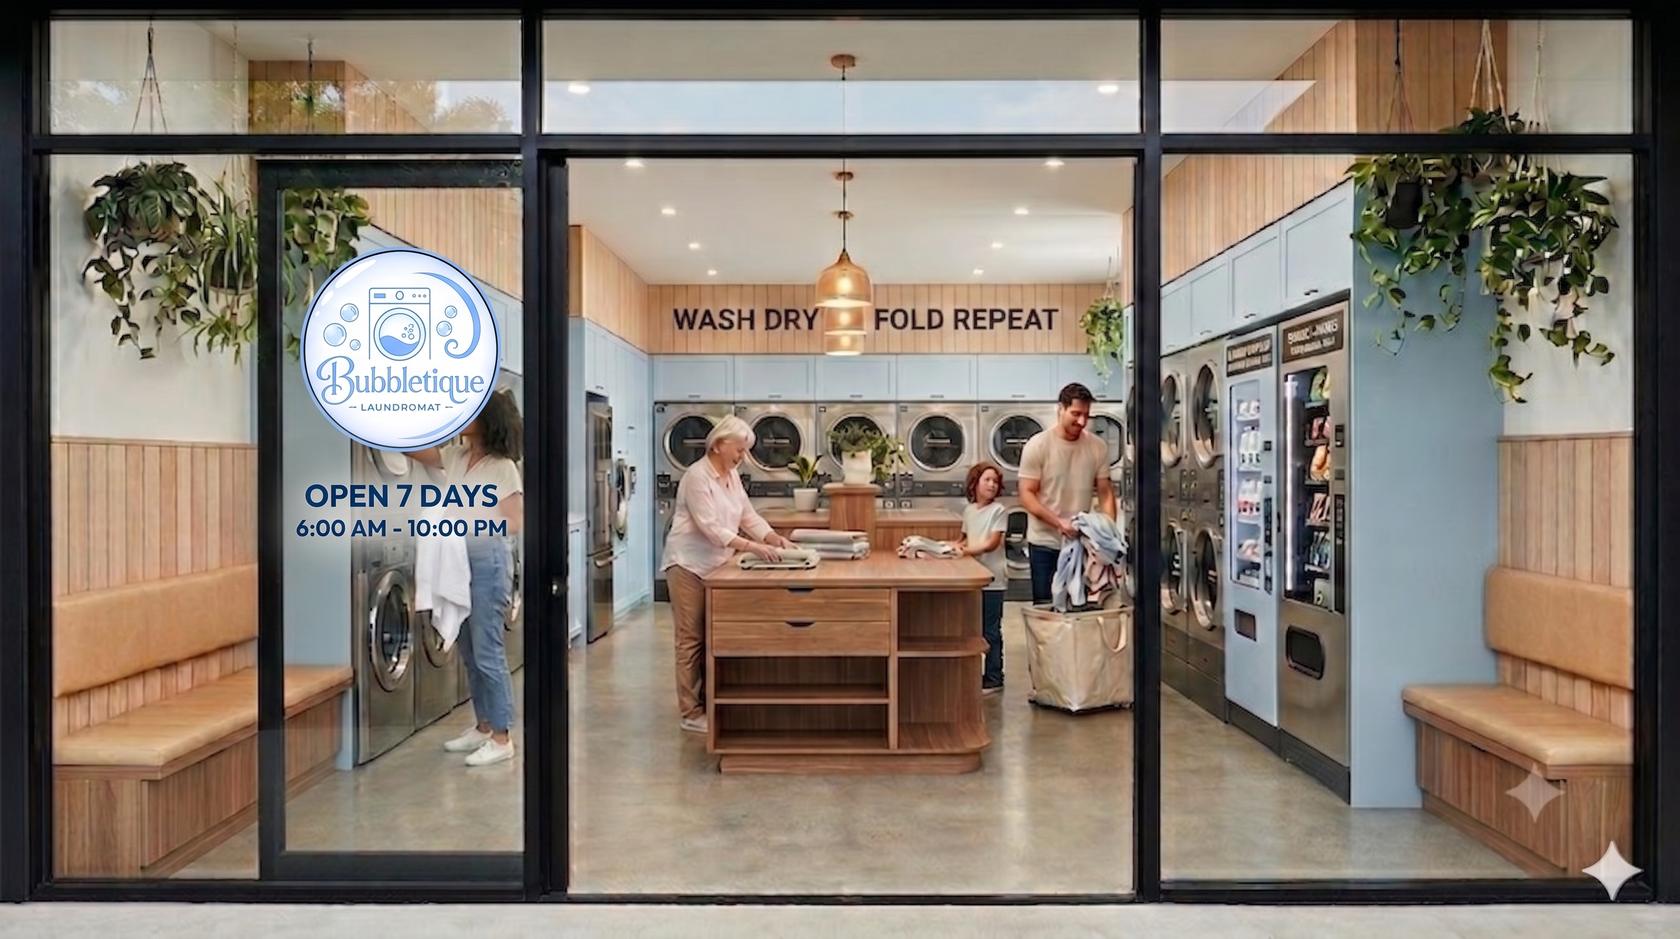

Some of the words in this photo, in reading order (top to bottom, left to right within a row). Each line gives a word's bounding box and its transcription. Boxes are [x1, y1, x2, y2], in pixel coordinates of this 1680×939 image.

[672, 308, 755, 331] WASH
[764, 308, 820, 331] DRY
[874, 308, 944, 331] FOLD
[953, 308, 1059, 331] REPEAT
[316, 355, 484, 405] Bubbletique
[360, 403, 442, 412] LAUNDROMAT
[305, 484, 388, 507] OPEN
[396, 484, 413, 508] 7
[420, 484, 499, 508] DAYS
[296, 519, 346, 538] 6:00
[351, 519, 387, 537] AM
[407, 519, 469, 537] 10:00
[474, 519, 508, 537] PM
